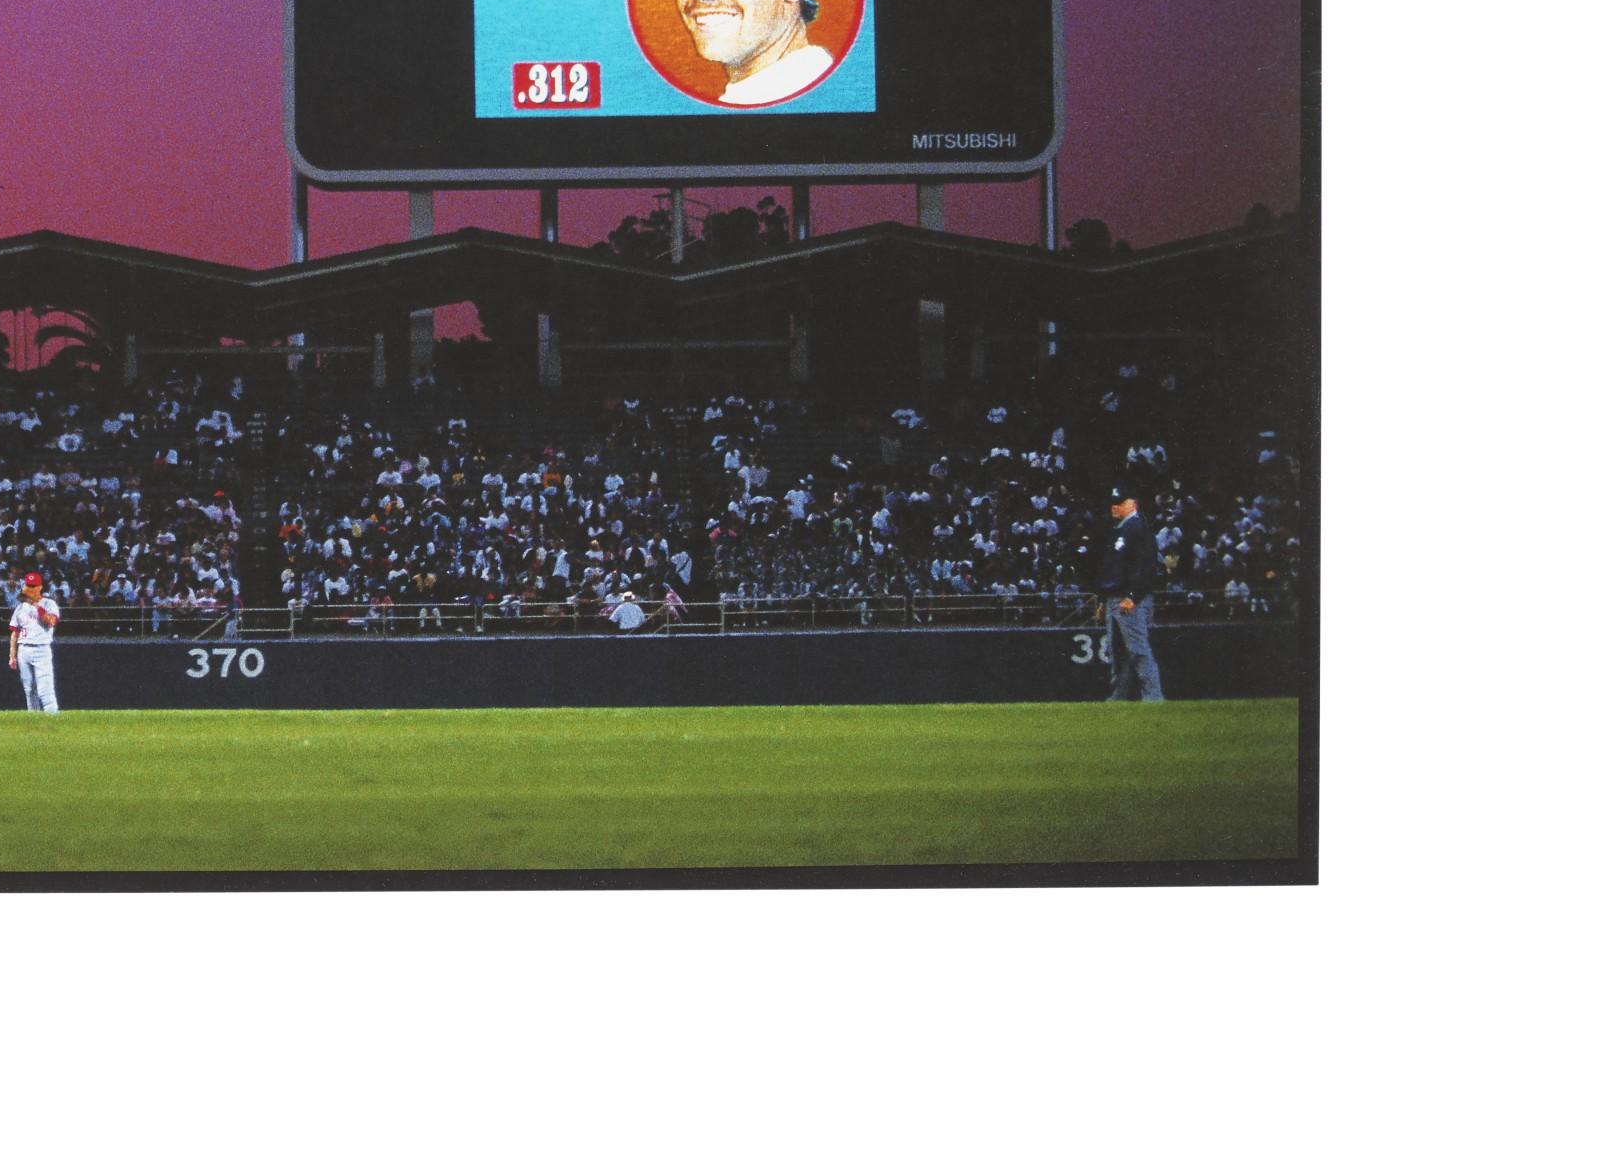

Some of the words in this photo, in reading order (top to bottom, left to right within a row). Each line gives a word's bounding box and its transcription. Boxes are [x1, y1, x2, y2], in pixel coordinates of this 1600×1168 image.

[517, 63, 590, 104] .312
[911, 133, 1017, 150] MITSUBISHI
[185, 647, 266, 679] 370
